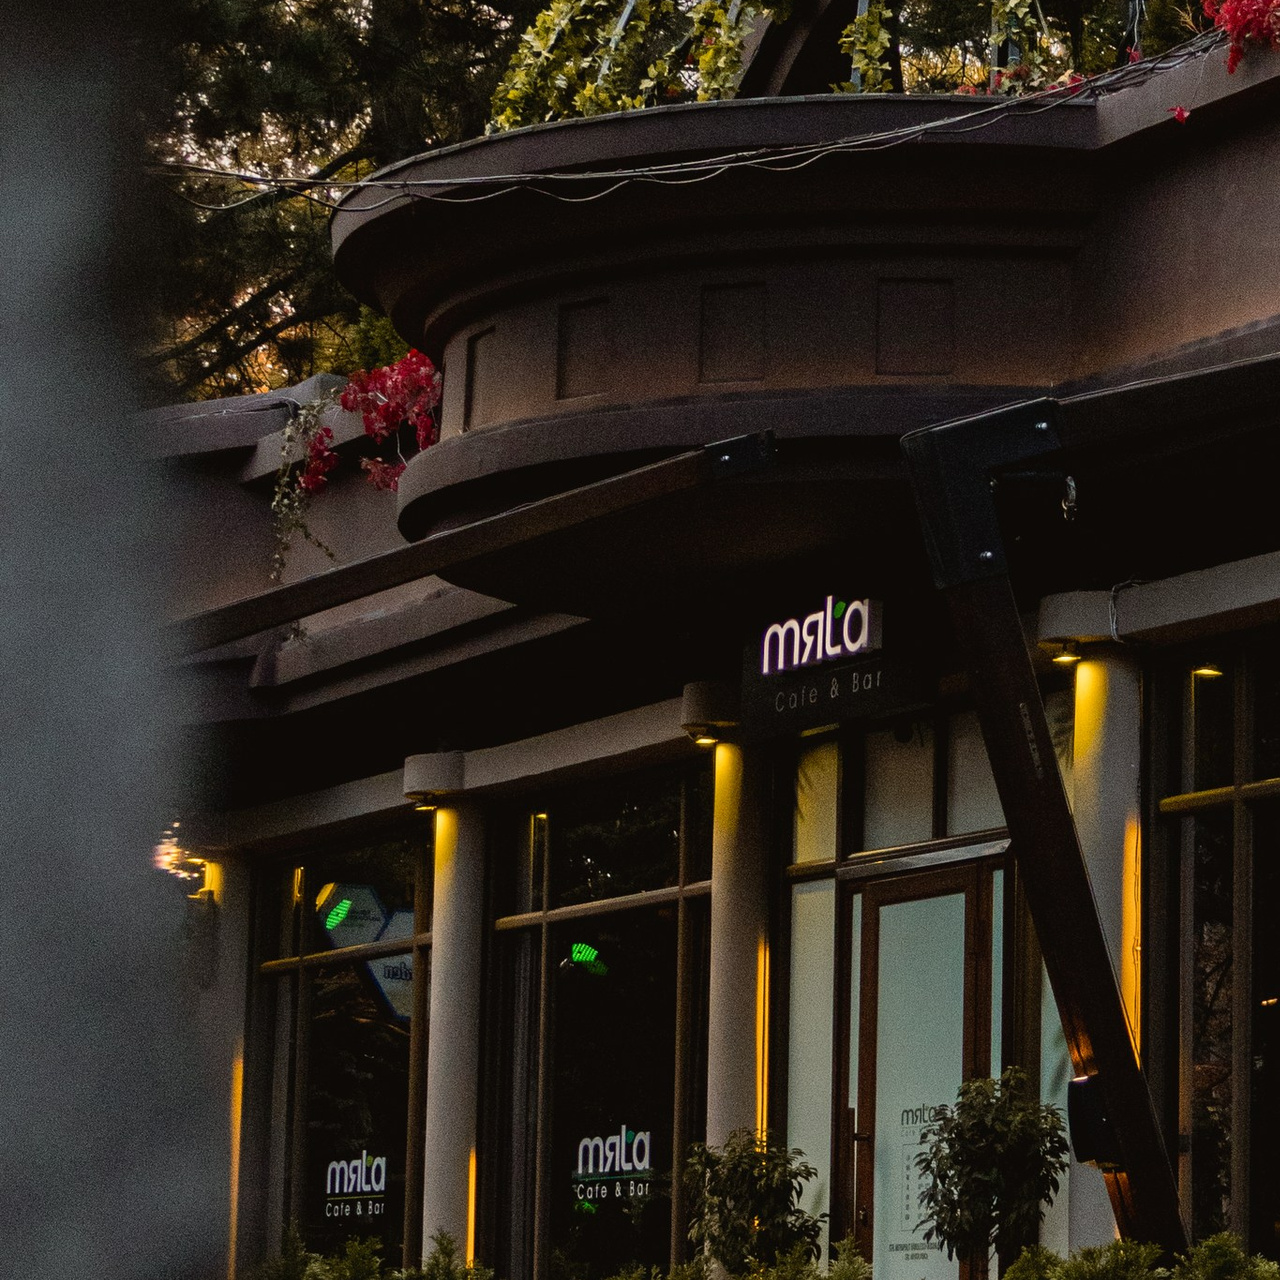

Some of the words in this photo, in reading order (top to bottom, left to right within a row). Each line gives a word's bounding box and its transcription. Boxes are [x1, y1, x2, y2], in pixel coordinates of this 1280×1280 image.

[775, 686, 818, 712] Cafe
[830, 678, 839, 698] &
[852, 671, 882, 693] Bar
[577, 1183, 607, 1199] Cafe
[615, 1181, 621, 1197] &
[629, 1181, 649, 1196] Bar
[326, 1202, 350, 1217] Cafe
[356, 1201, 362, 1215] &
[368, 1201, 385, 1215] Bar
